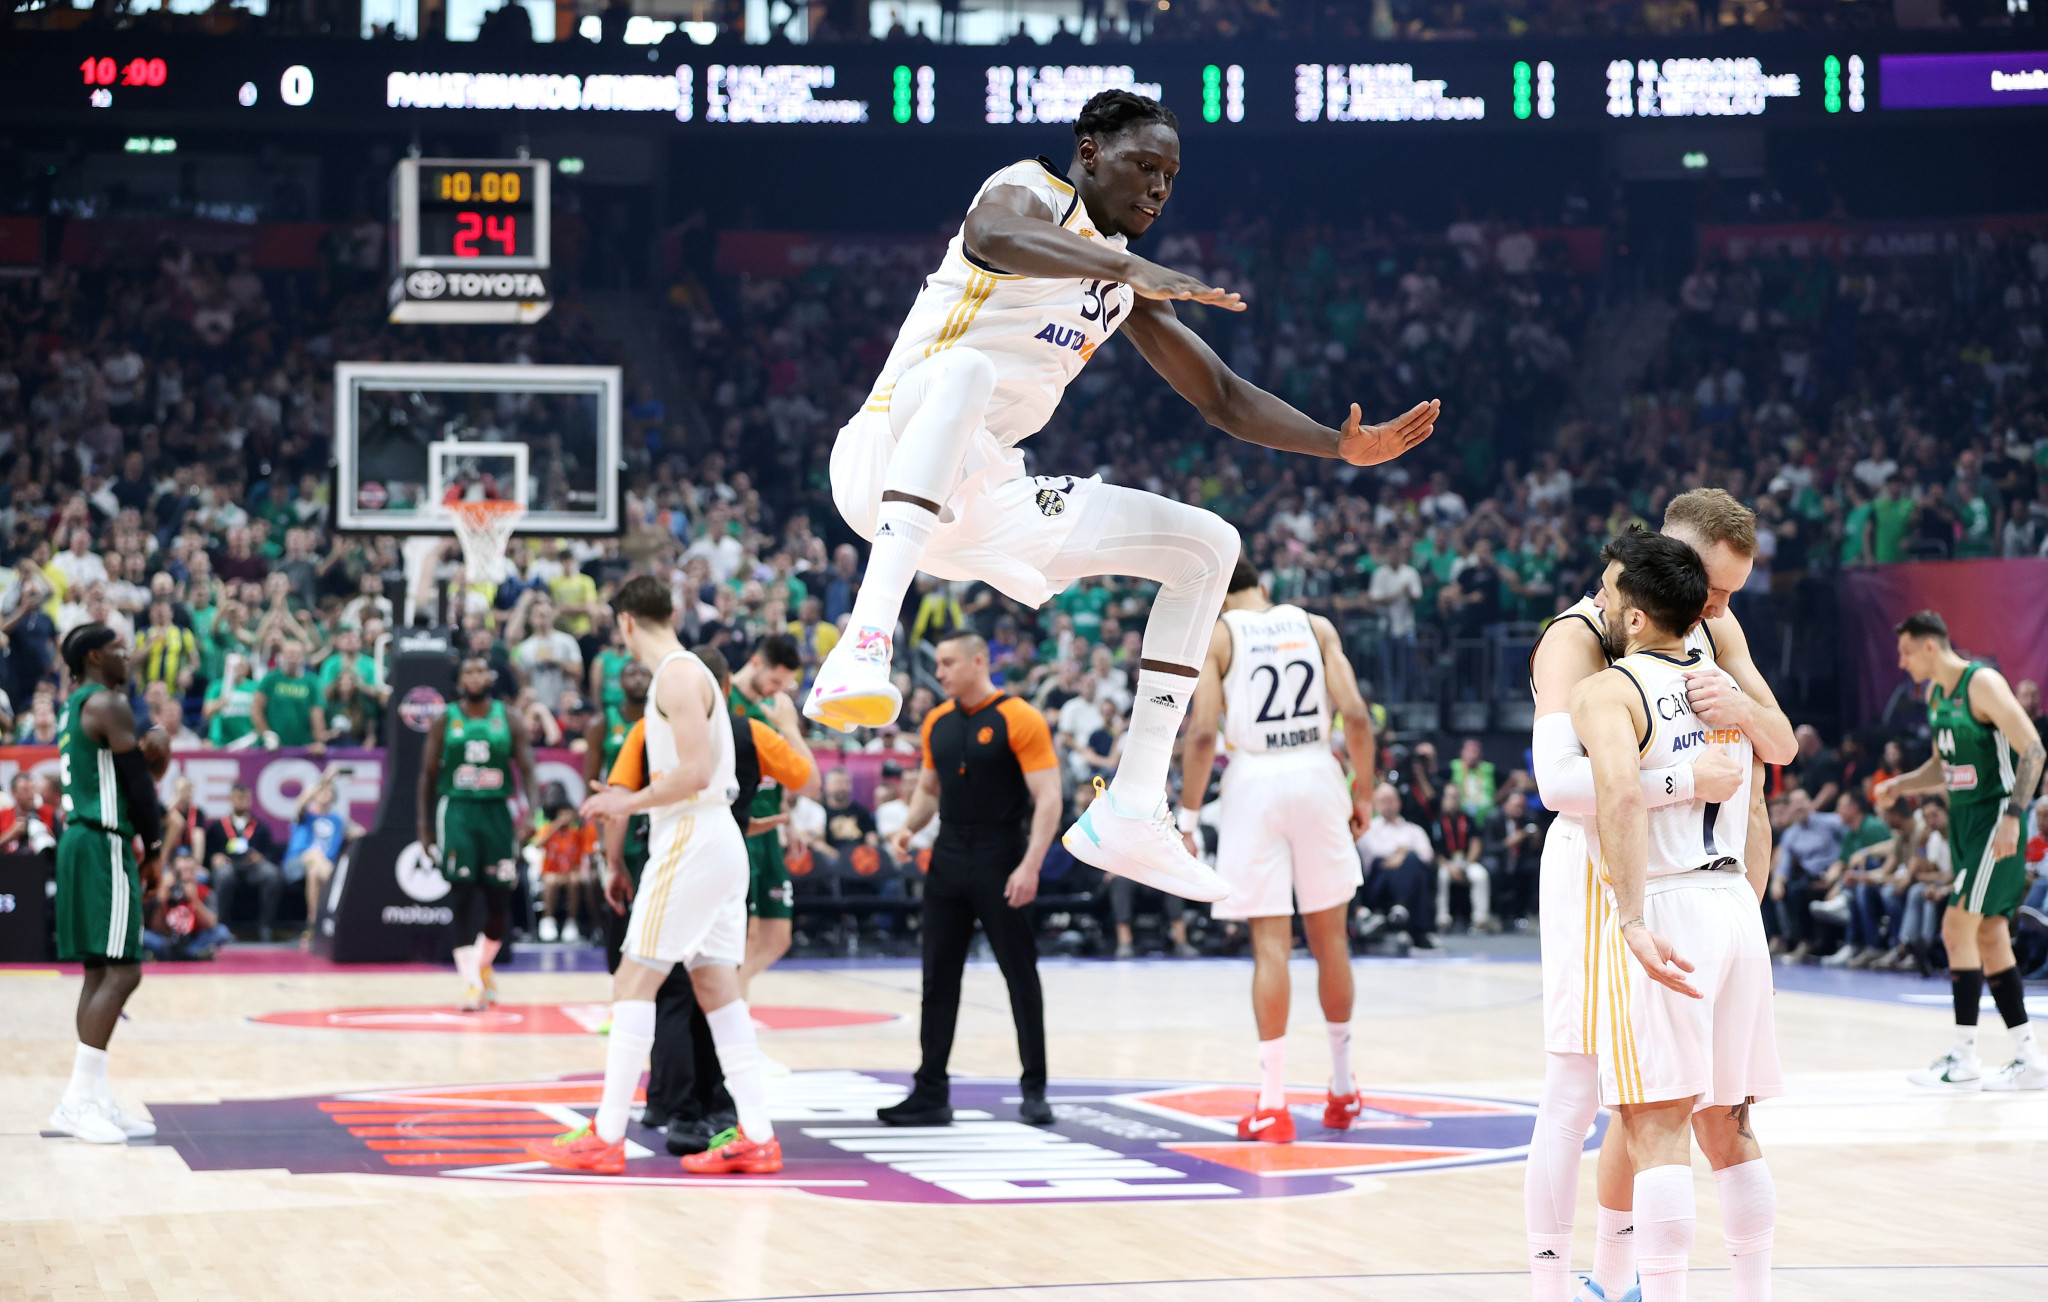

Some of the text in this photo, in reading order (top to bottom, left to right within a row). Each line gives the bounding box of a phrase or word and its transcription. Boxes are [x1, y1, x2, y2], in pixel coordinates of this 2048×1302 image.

[281, 64, 314, 106] 0
[453, 211, 516, 258] 24
[446, 273, 546, 297] TOYOTA
[1251, 660, 1319, 723] 22
